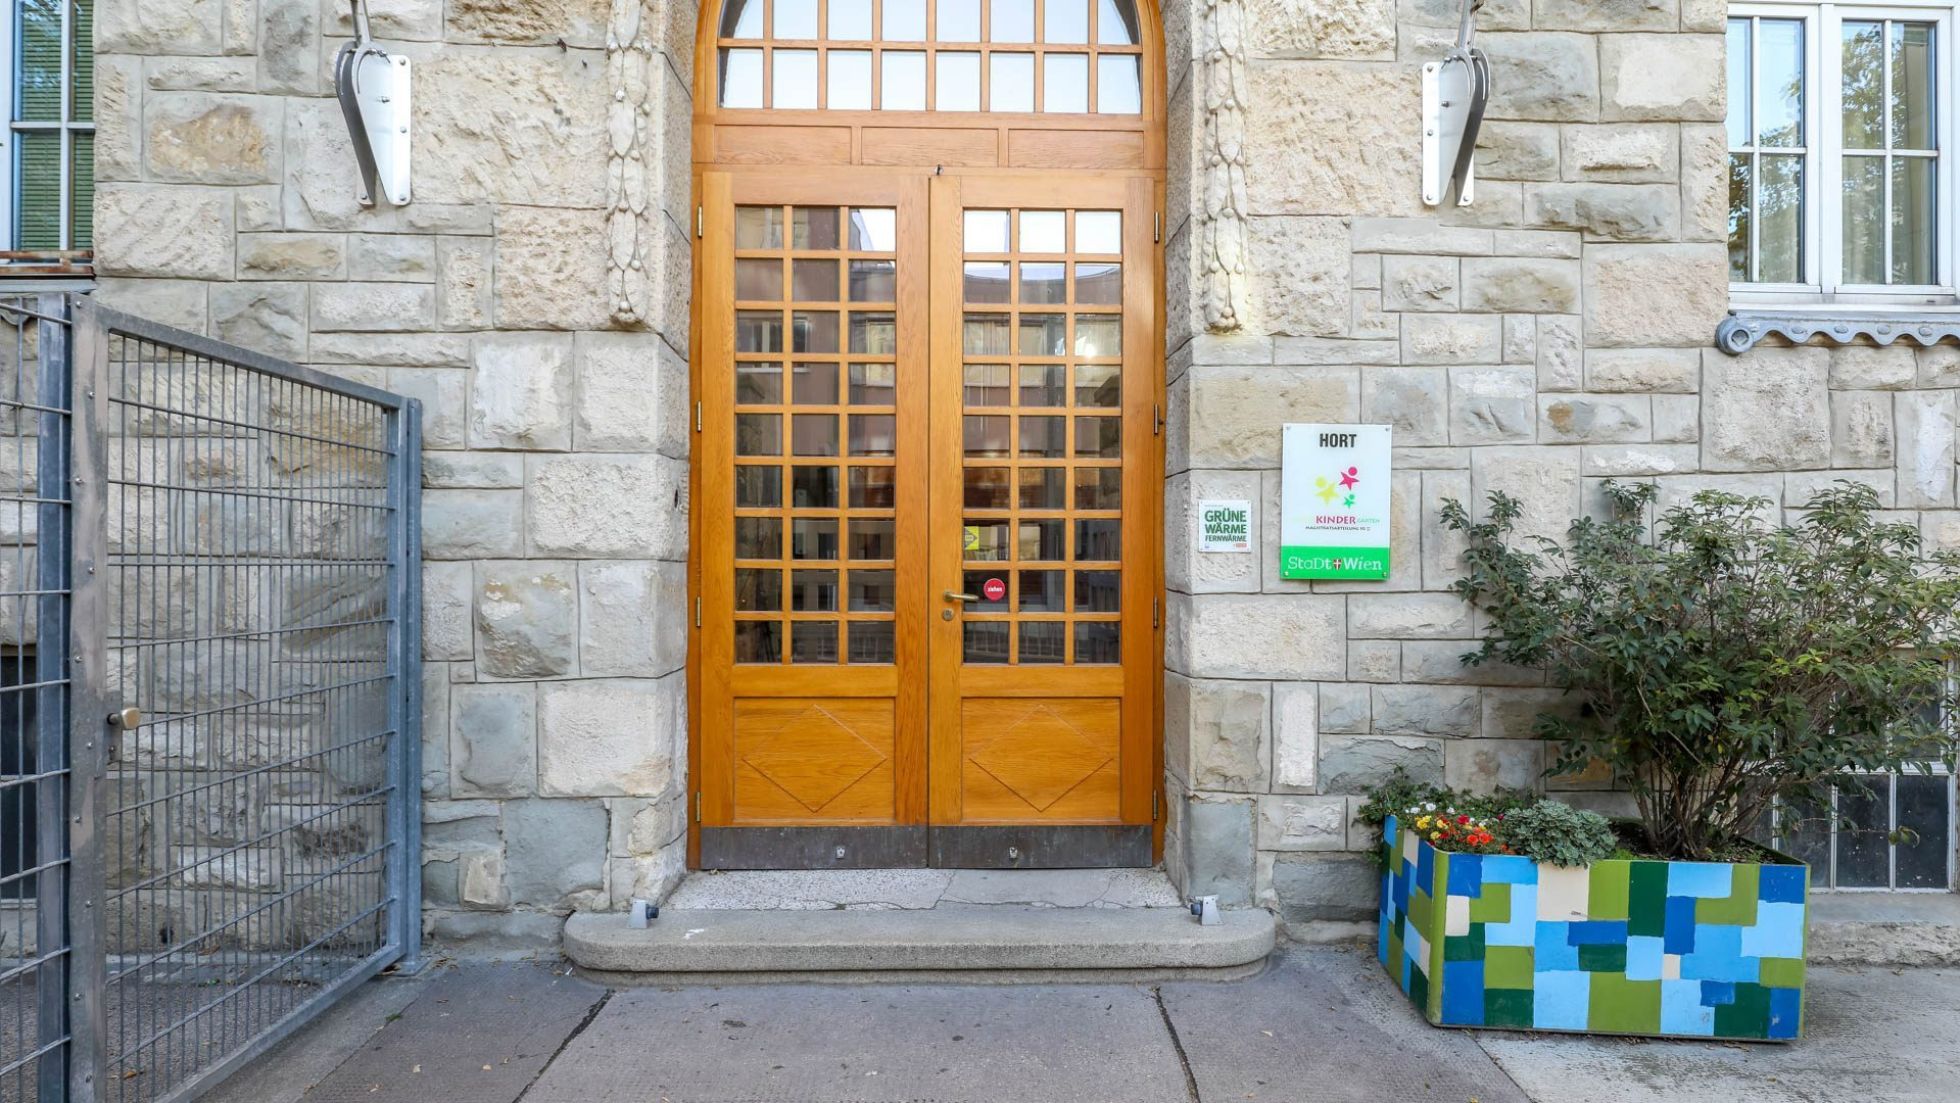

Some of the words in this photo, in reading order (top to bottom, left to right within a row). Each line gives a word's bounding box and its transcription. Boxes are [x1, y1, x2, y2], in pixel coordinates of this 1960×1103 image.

[1320, 433, 1357, 448] HORT
[1204, 507, 1247, 523] GRÜNE
[1315, 515, 1356, 525] KINDER
[1204, 522, 1247, 534] WÄRME
[1205, 534, 1247, 542] FERNWÄRME
[1345, 556, 1382, 571] Wien
